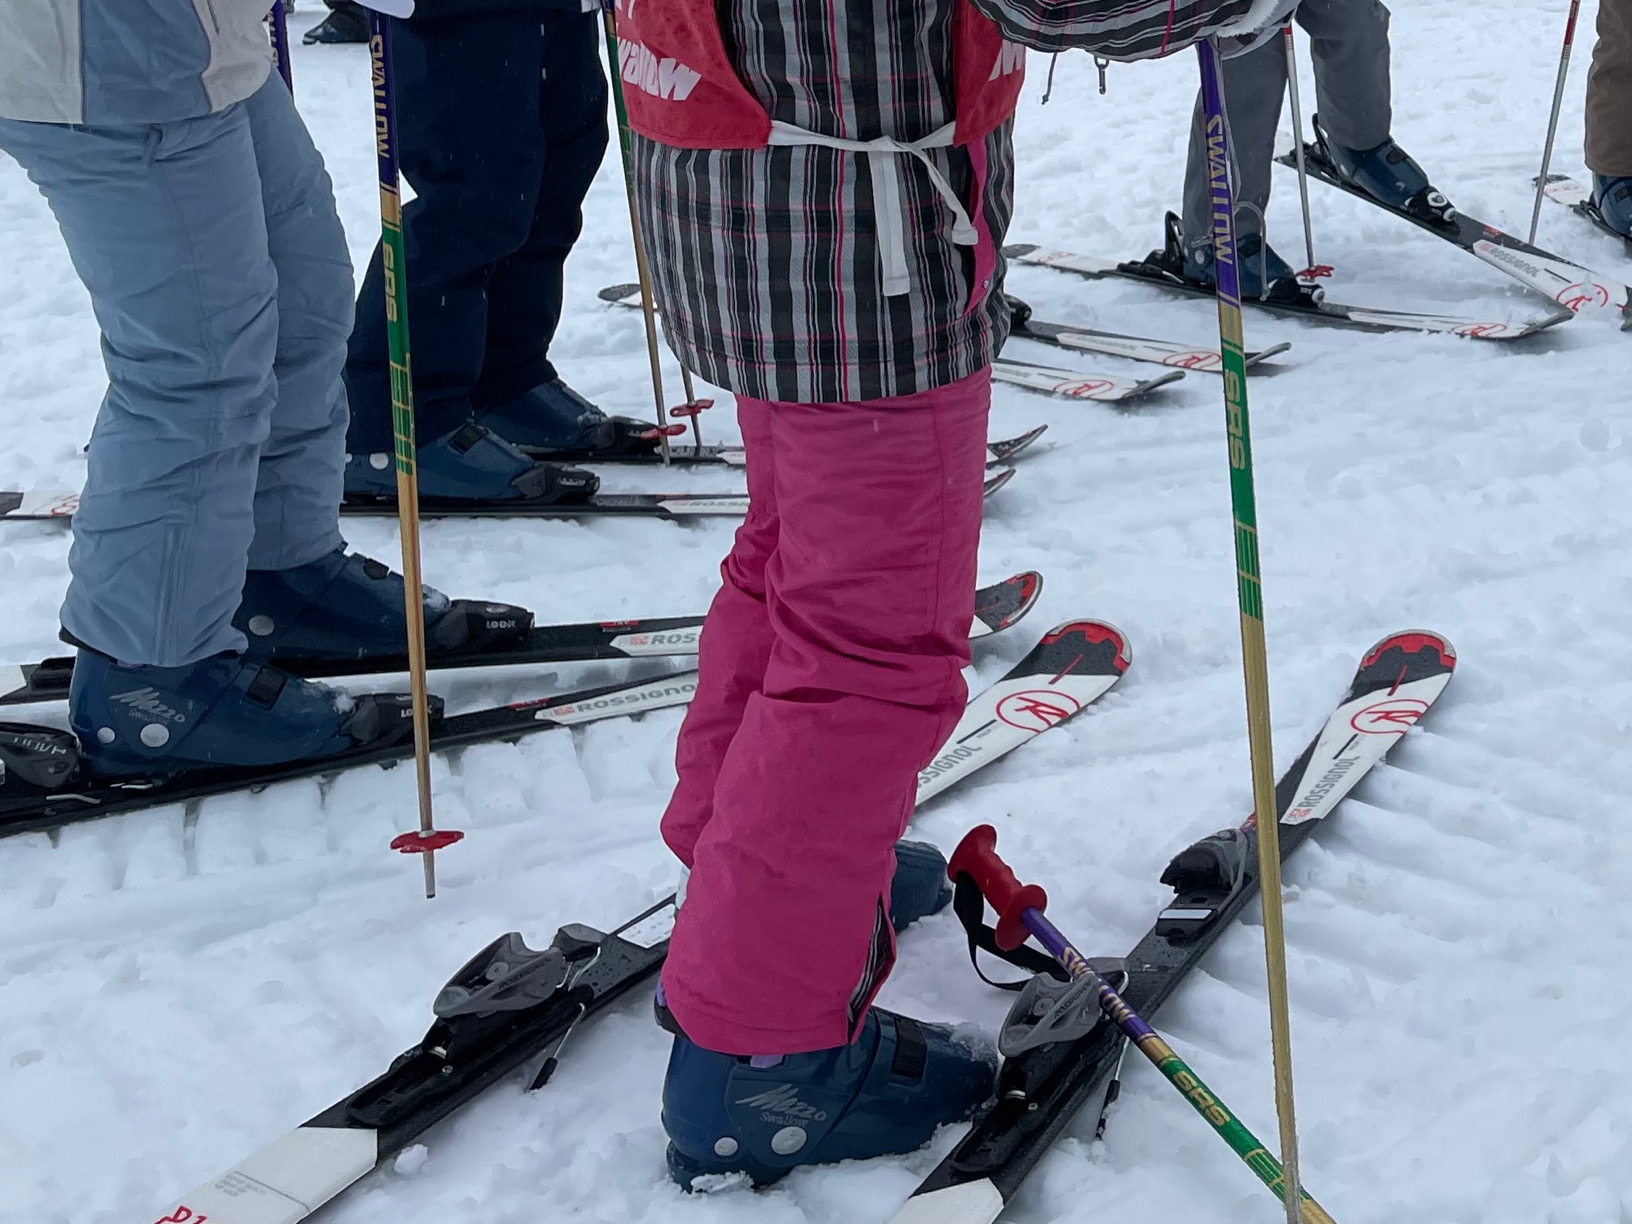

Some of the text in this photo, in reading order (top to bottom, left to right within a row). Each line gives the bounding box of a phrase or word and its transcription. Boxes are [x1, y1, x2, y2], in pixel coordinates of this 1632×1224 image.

[1225, 368, 1246, 470] SRS
[1301, 755, 1360, 808] ROSSIGNOL
[759, 1111, 810, 1127] Swallow
[1173, 1070, 1231, 1127] SRS
